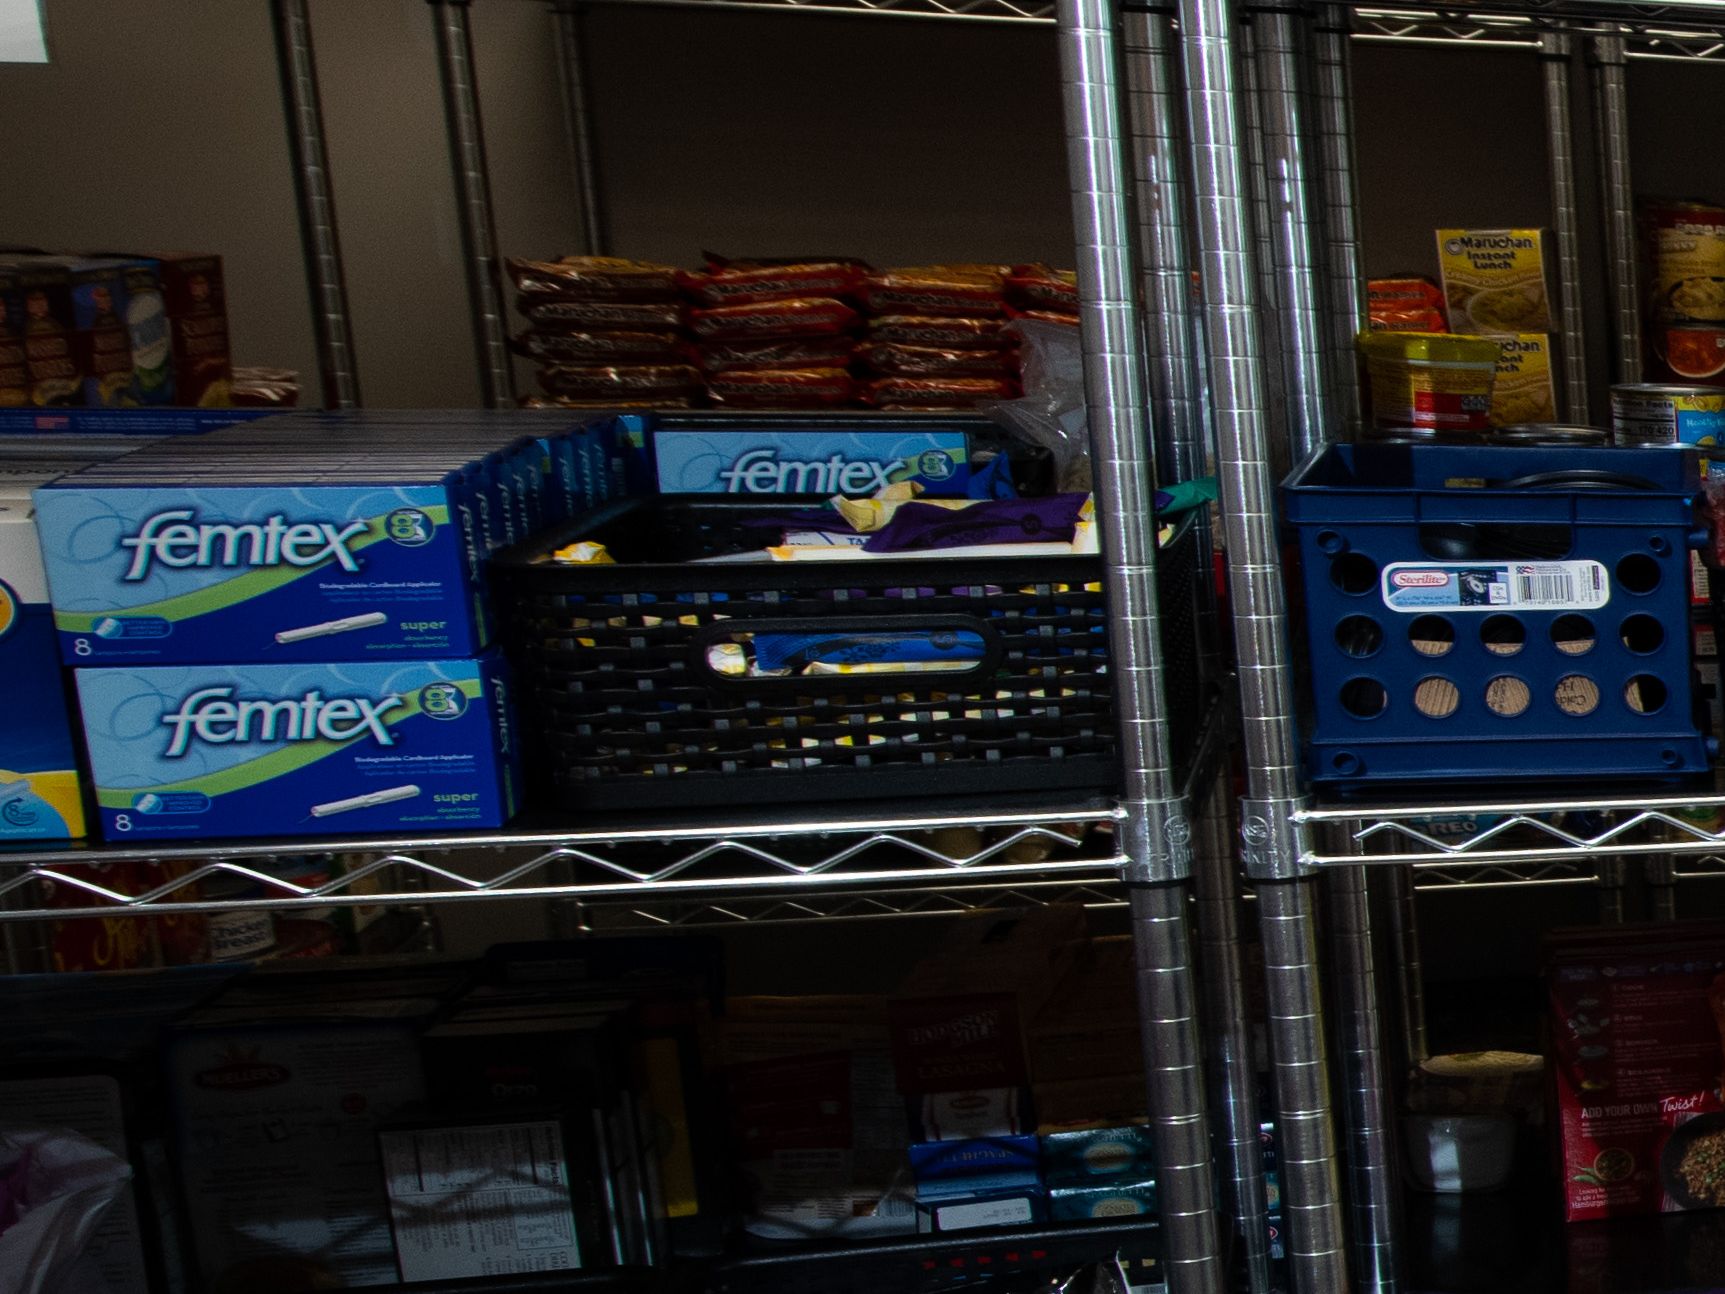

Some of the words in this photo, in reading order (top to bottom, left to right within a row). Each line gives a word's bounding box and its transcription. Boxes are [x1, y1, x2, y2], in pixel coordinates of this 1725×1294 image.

[1460, 234, 1534, 251] Maruchan
[1466, 250, 1516, 262] Instant
[1473, 259, 1513, 271] Lunch
[718, 449, 905, 496] femtex
[120, 508, 372, 582] femtex
[1399, 574, 1446, 585] Sterilite
[400, 619, 447, 633] super
[73, 637, 92, 657] 8
[161, 687, 404, 759] femtex
[433, 791, 479, 805] super
[113, 813, 133, 832] 8
[915, 1059, 1007, 1079] LASAGNA
